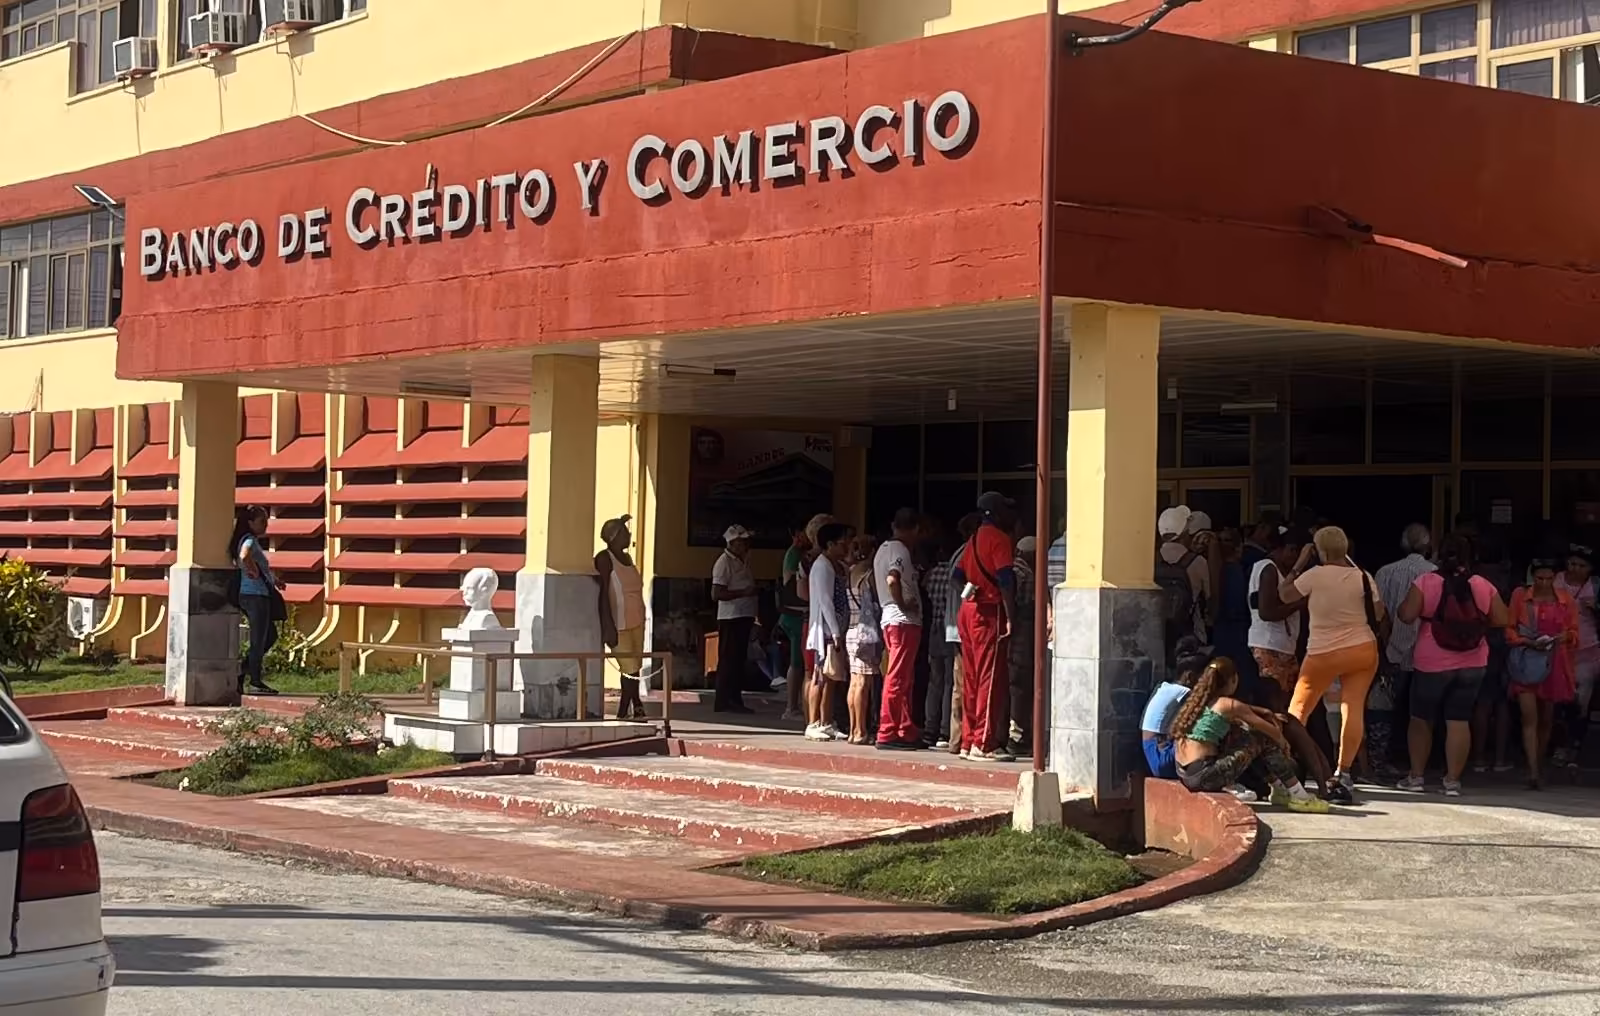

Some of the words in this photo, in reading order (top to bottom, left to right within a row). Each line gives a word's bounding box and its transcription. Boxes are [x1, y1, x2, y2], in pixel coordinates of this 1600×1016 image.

[140, 218, 259, 276] BANCO
[278, 207, 328, 258] DE
[345, 162, 551, 244] CRÉDITO
[573, 158, 604, 210] Y
[626, 90, 972, 200] COMERCIO
